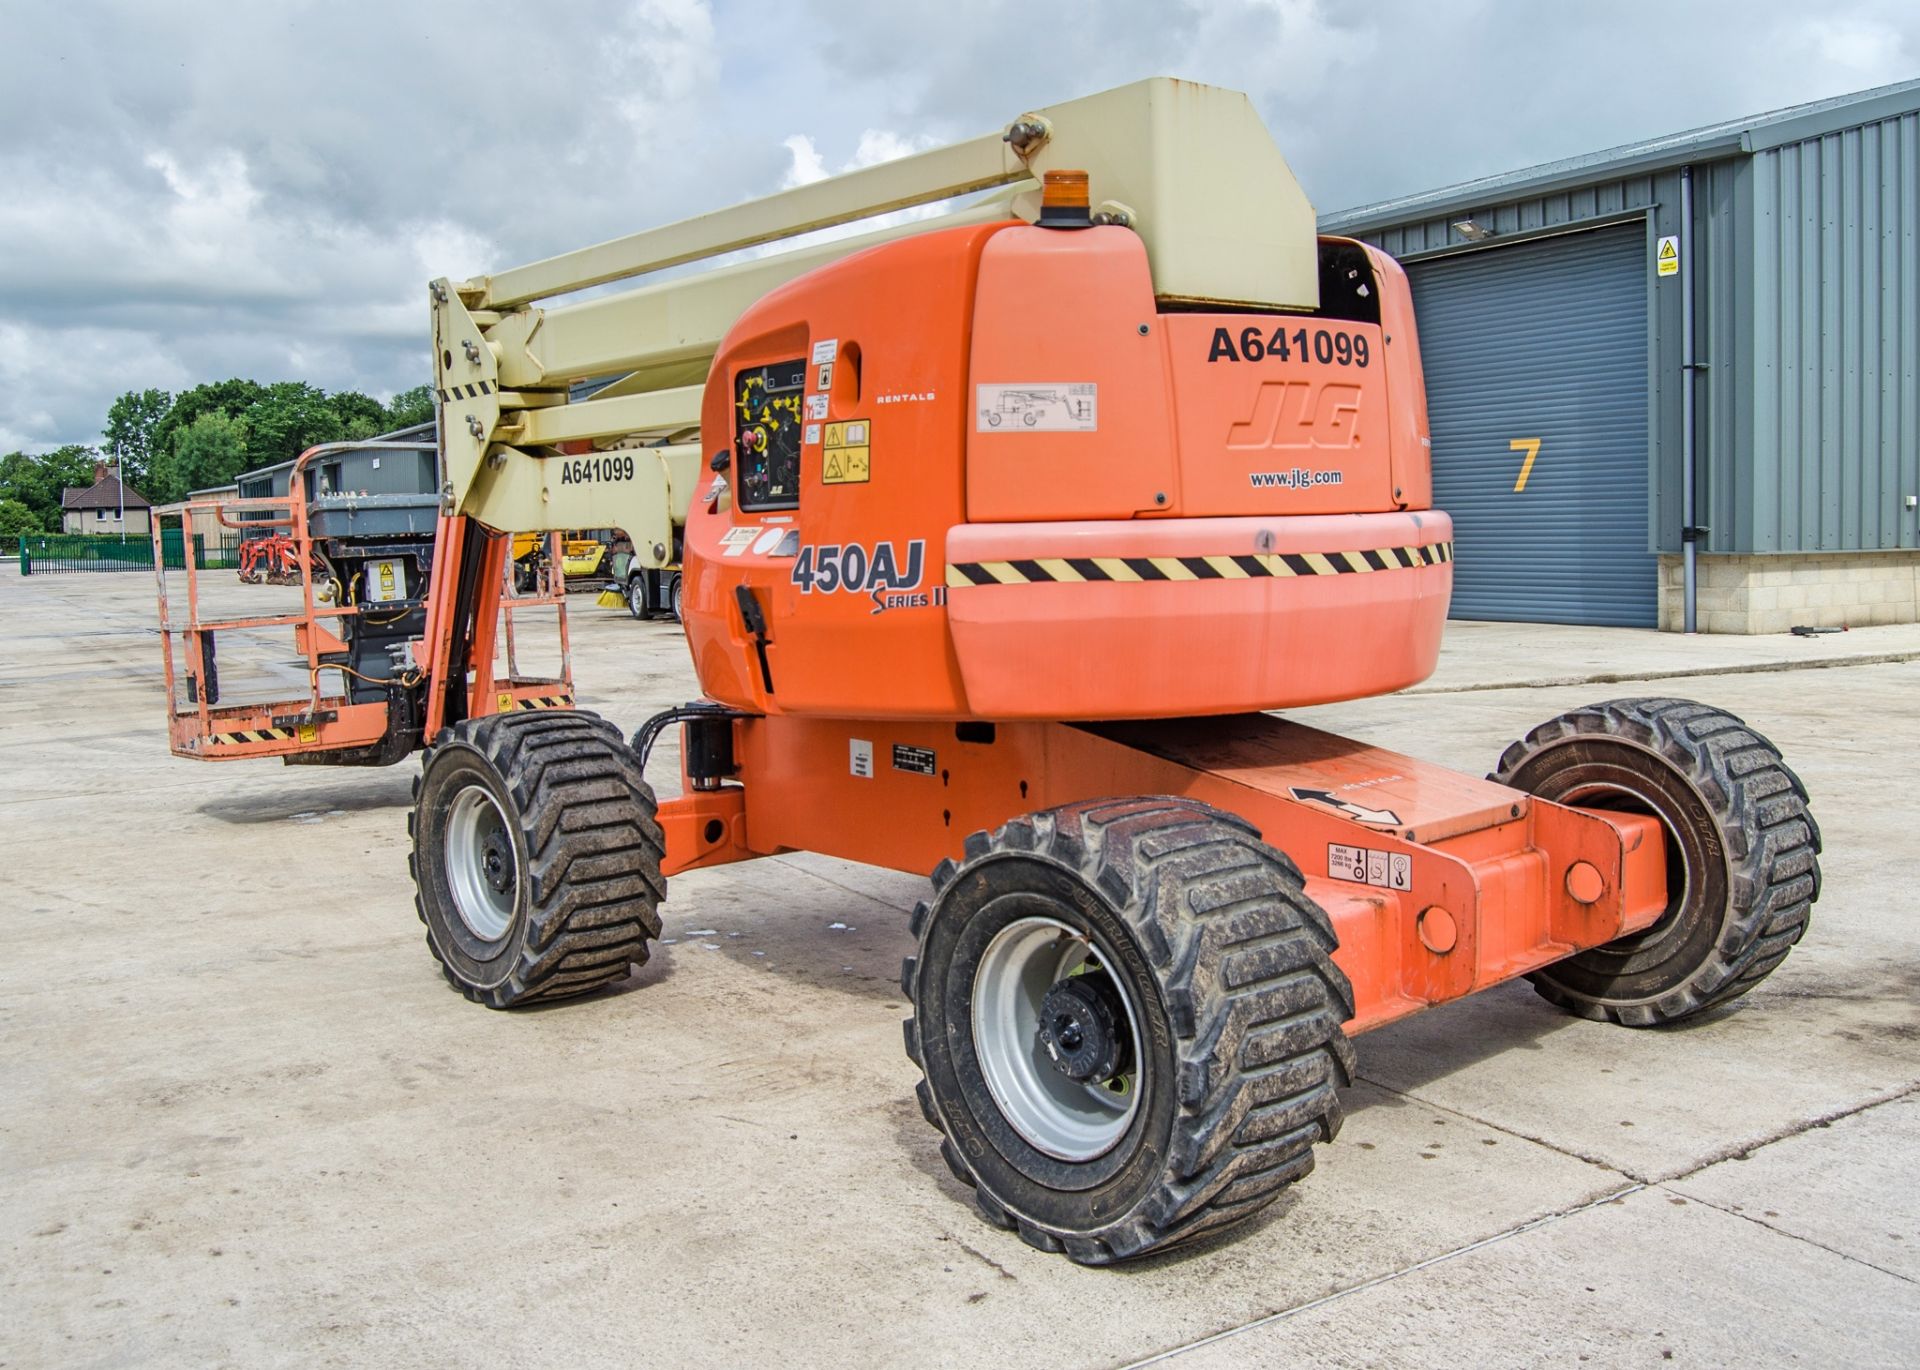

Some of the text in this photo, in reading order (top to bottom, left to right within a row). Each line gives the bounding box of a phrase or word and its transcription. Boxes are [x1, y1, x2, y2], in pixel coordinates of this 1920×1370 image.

[1207, 327, 1369, 368] A641099
[877, 392, 936, 404] RENTALS
[1226, 380, 1362, 449] JLG
[561, 456, 634, 485] A641099
[1250, 469, 1343, 489] www.jlg.com
[1510, 438, 1541, 492] 7
[791, 539, 926, 594] 450AJ
[1330, 853, 1344, 861] 7200
[1056, 876, 1170, 1049] OUTRIGGER
